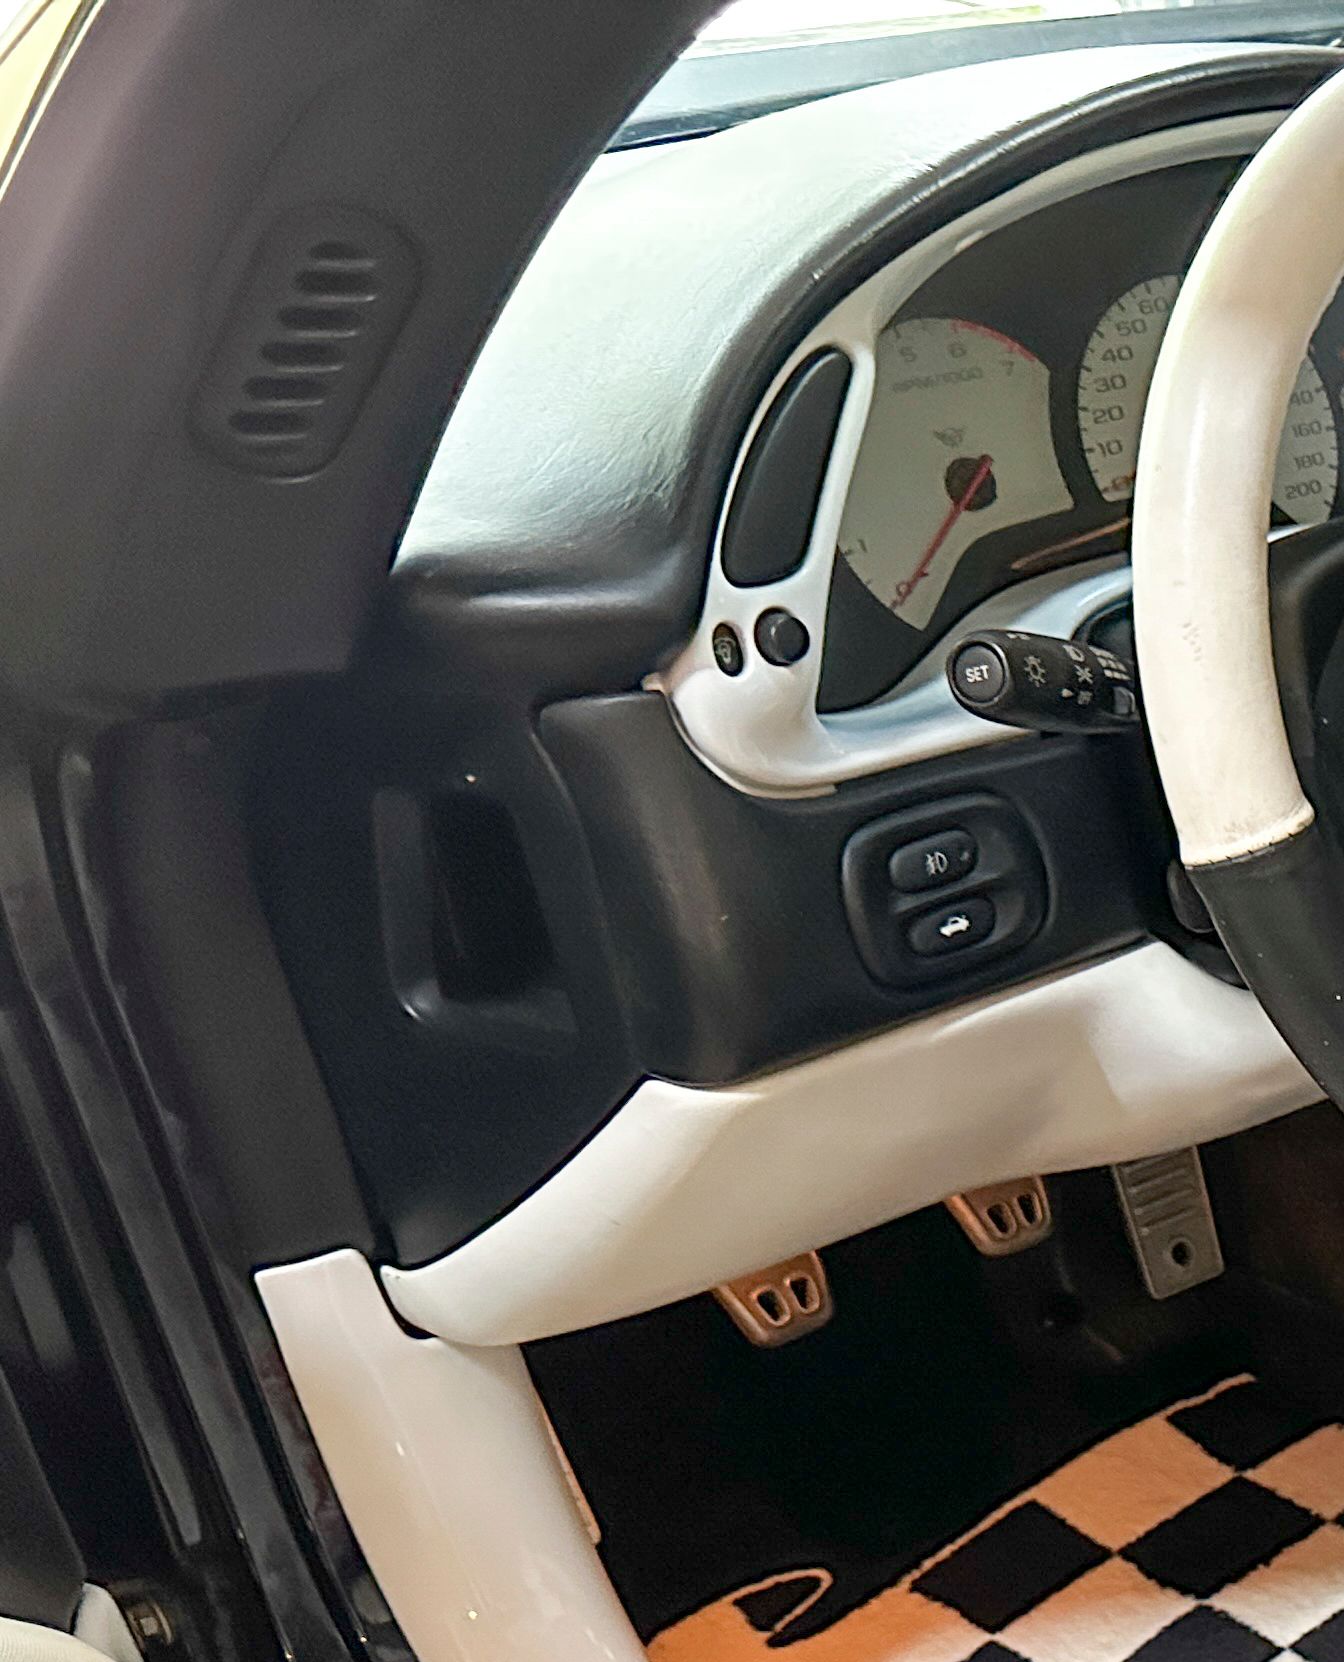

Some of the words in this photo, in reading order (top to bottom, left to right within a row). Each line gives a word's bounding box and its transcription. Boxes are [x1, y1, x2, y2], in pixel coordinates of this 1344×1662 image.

[1138, 297, 1168, 315] 60
[1115, 318, 1147, 336] 50
[1101, 345, 1133, 362] 40
[1093, 374, 1127, 393] 30
[1092, 405, 1124, 424] 20
[1292, 421, 1323, 438] 160
[1097, 439, 1123, 457] 10
[1294, 452, 1325, 469] 180
[1284, 480, 1323, 500] 200
[965, 664, 990, 683] SET
